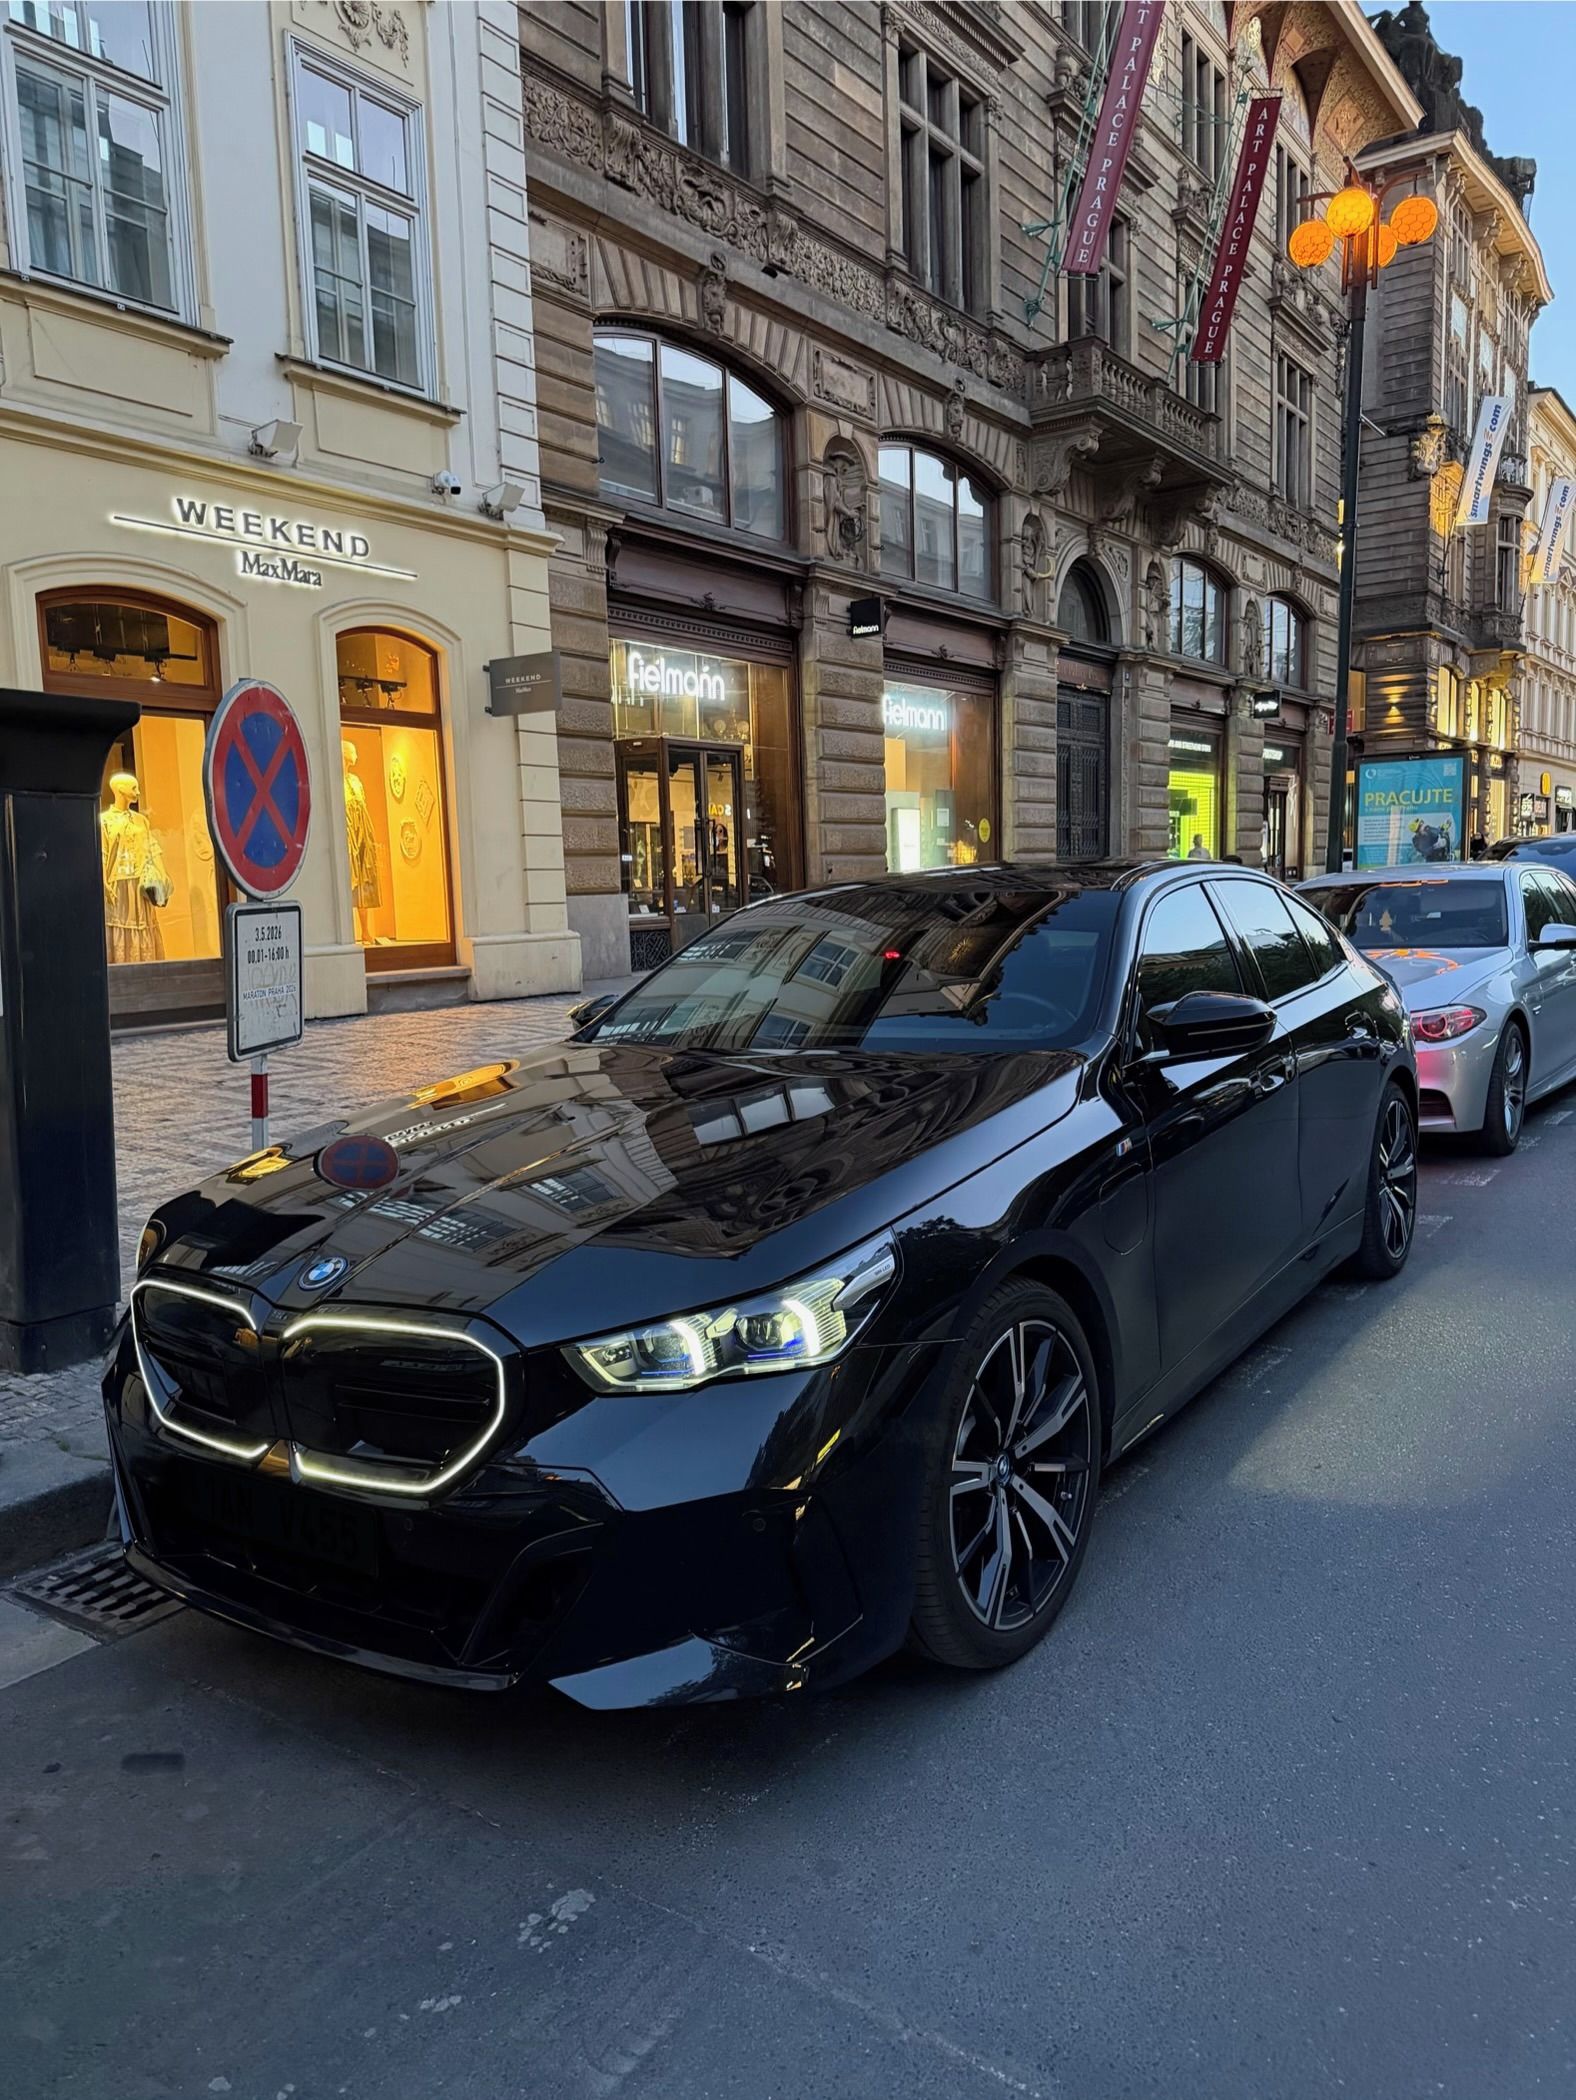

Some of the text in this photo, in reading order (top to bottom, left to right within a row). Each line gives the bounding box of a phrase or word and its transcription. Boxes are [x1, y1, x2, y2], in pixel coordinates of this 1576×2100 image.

[1107, 37, 1142, 147] PALACE
[1077, 158, 1112, 263] PRAGUE
[1204, 106, 1269, 355] ART PALACE PRAGUE
[1470, 442, 1493, 518] smartwings
[175, 497, 370, 558] WEEKEND
[240, 551, 322, 587] MaxMara
[505, 674, 541, 684] WEEKEND
[627, 651, 725, 701] fielmann
[1364, 788, 1453, 807] PRACUJTE
[255, 925, 282, 941] 3.5.2026
[268, 986, 284, 997] PRAHA
